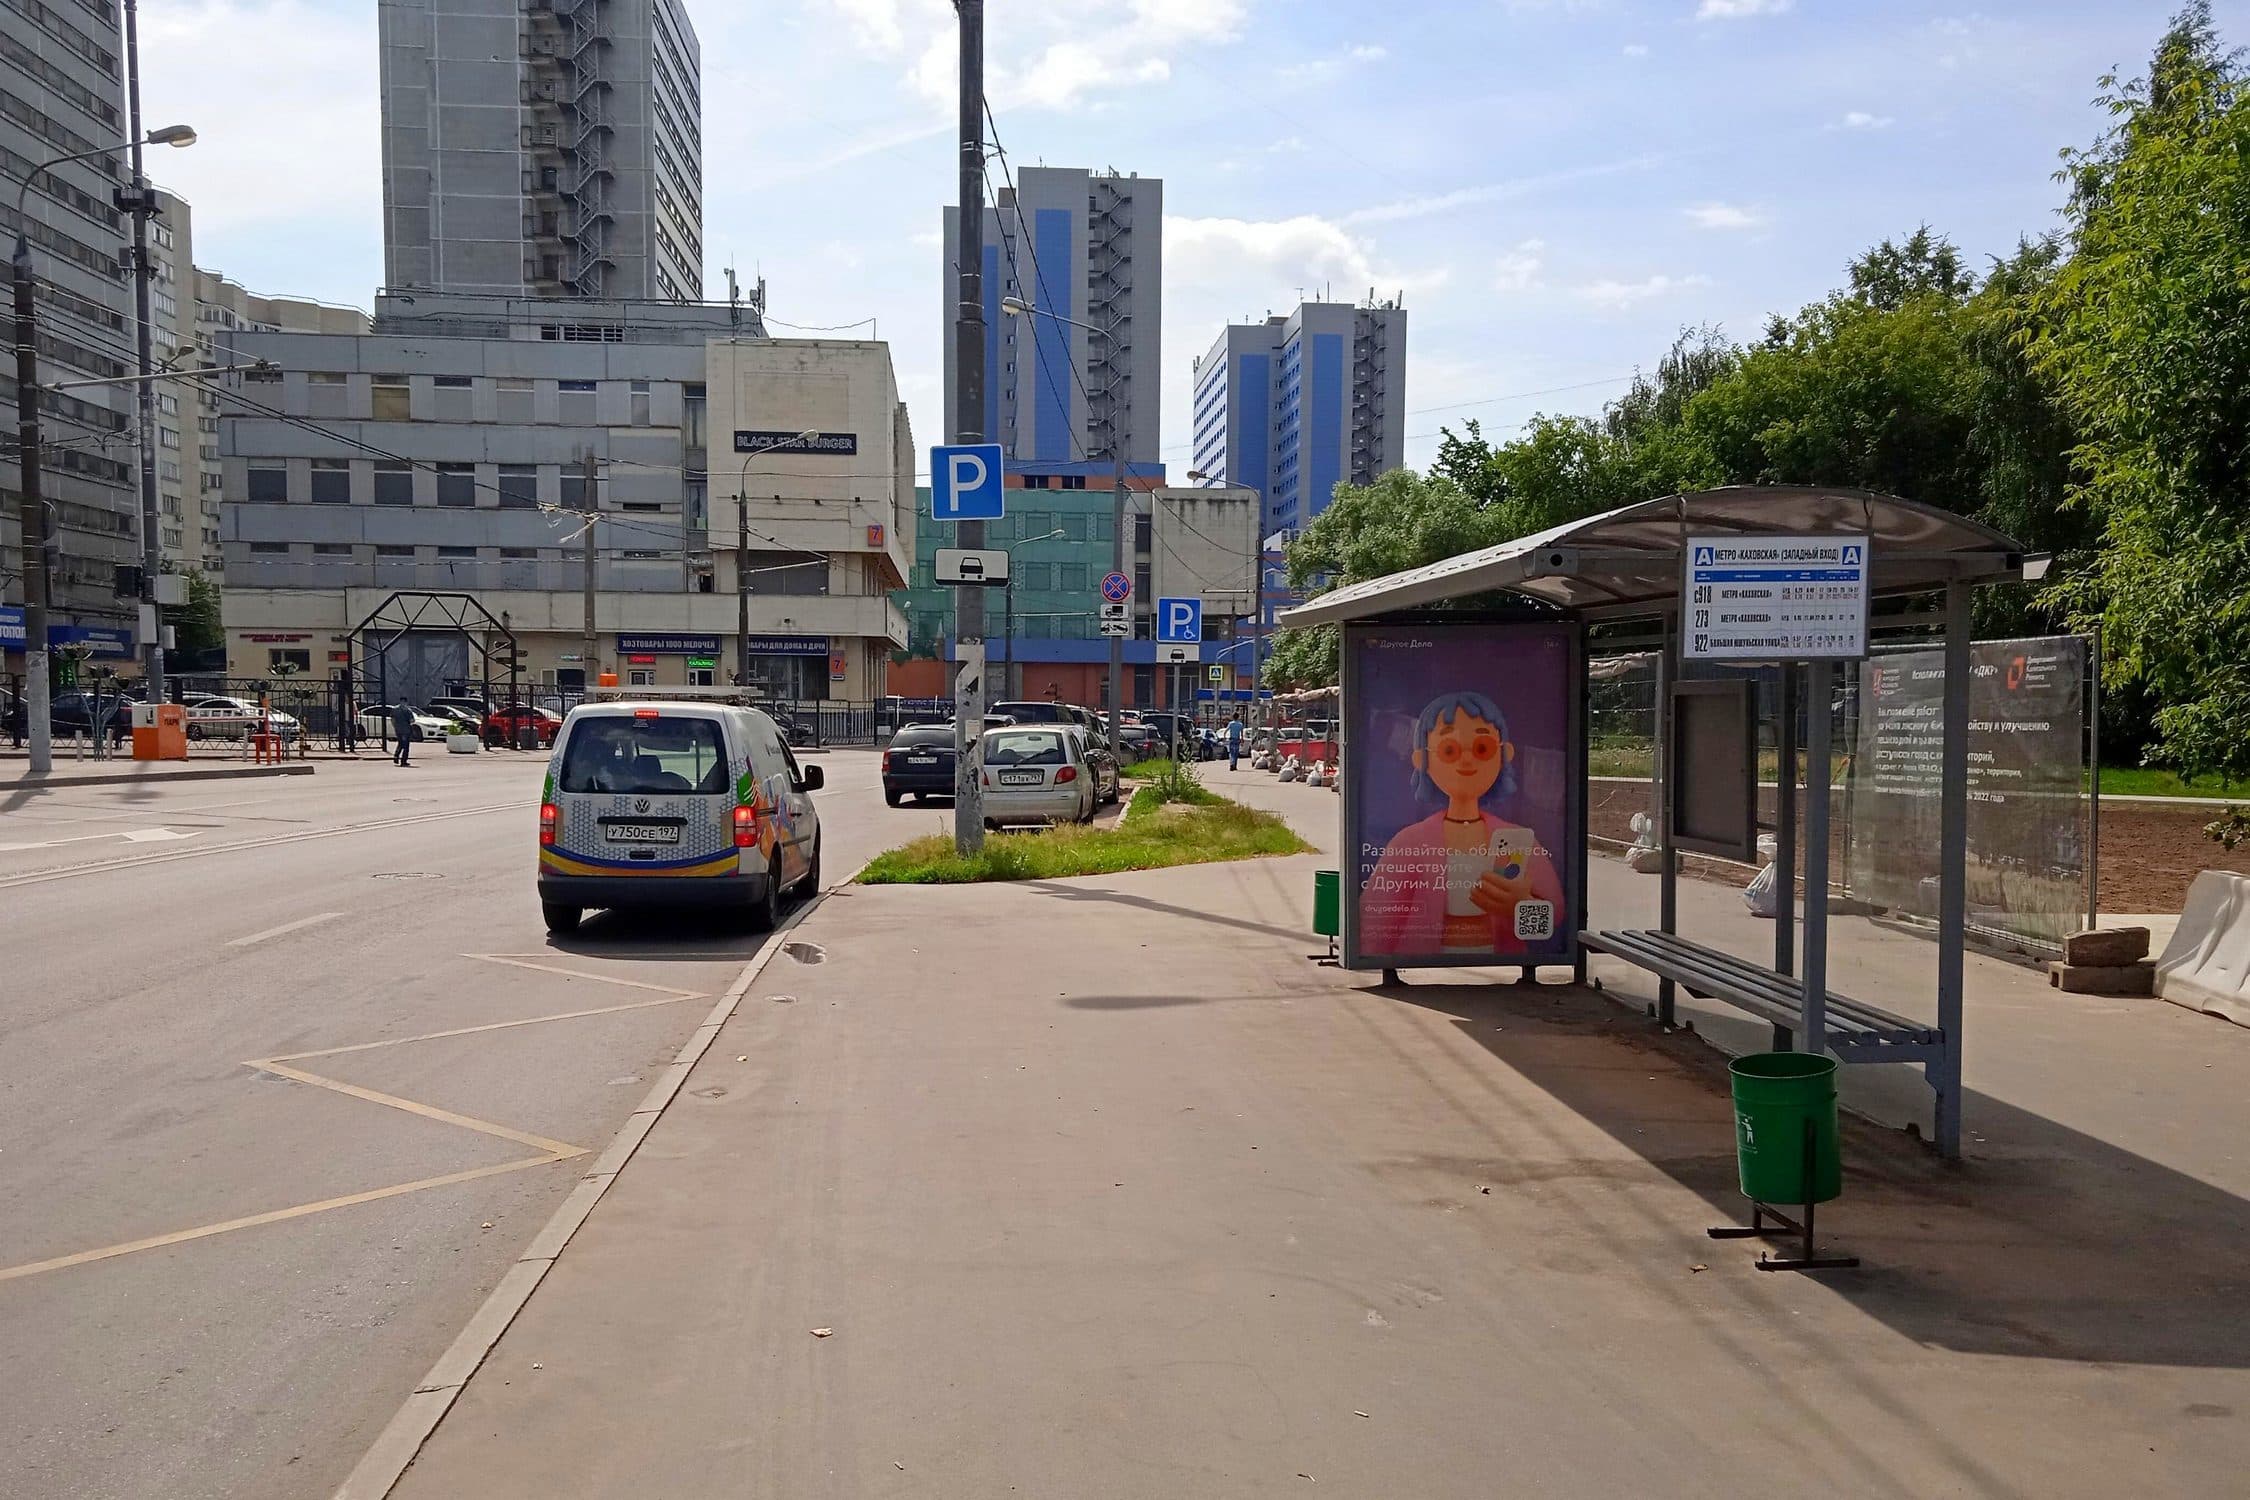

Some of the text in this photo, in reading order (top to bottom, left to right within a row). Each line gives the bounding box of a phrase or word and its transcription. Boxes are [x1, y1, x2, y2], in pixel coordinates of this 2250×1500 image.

[737, 436, 775, 447] BLACK
[807, 437, 852, 449] BURGER
[949, 454, 987, 512] P
[872, 527, 880, 540] 7
[1715, 549, 1737, 560] МЕТРО
[1737, 549, 1780, 560] «КАХОВСКАЯ»
[1781, 547, 1818, 561] (ЗАПАДНЫЙ
[1819, 548, 1839, 561] ВХОД)
[1721, 589, 1738, 598] МЕТРО
[1169, 603, 1194, 637] P
[1695, 609, 1709, 628] 273
[1721, 614, 1738, 623] МЕТРО
[622, 640, 716, 649] ХОЗТОВАРЫ 1000 МЕЛОЧЕЙ
[769, 642, 783, 650] ДЛЯ
[784, 642, 803, 650] ДОМА
[808, 642, 826, 650] ДАЧИ
[1380, 639, 1433, 649] Другое Дело
[1695, 634, 1708, 652] 922
[2000, 721, 2050, 733] улучшению
[1973, 792, 1988, 801] 2022
[658, 827, 675, 836] 197
[1362, 843, 1552, 858] Развивайтесь, общайтесь,
[1361, 862, 1472, 877] путешествуйте
[1361, 876, 1483, 892] с Другим Делом
[1364, 904, 1420, 914] drugoedelo.ru
